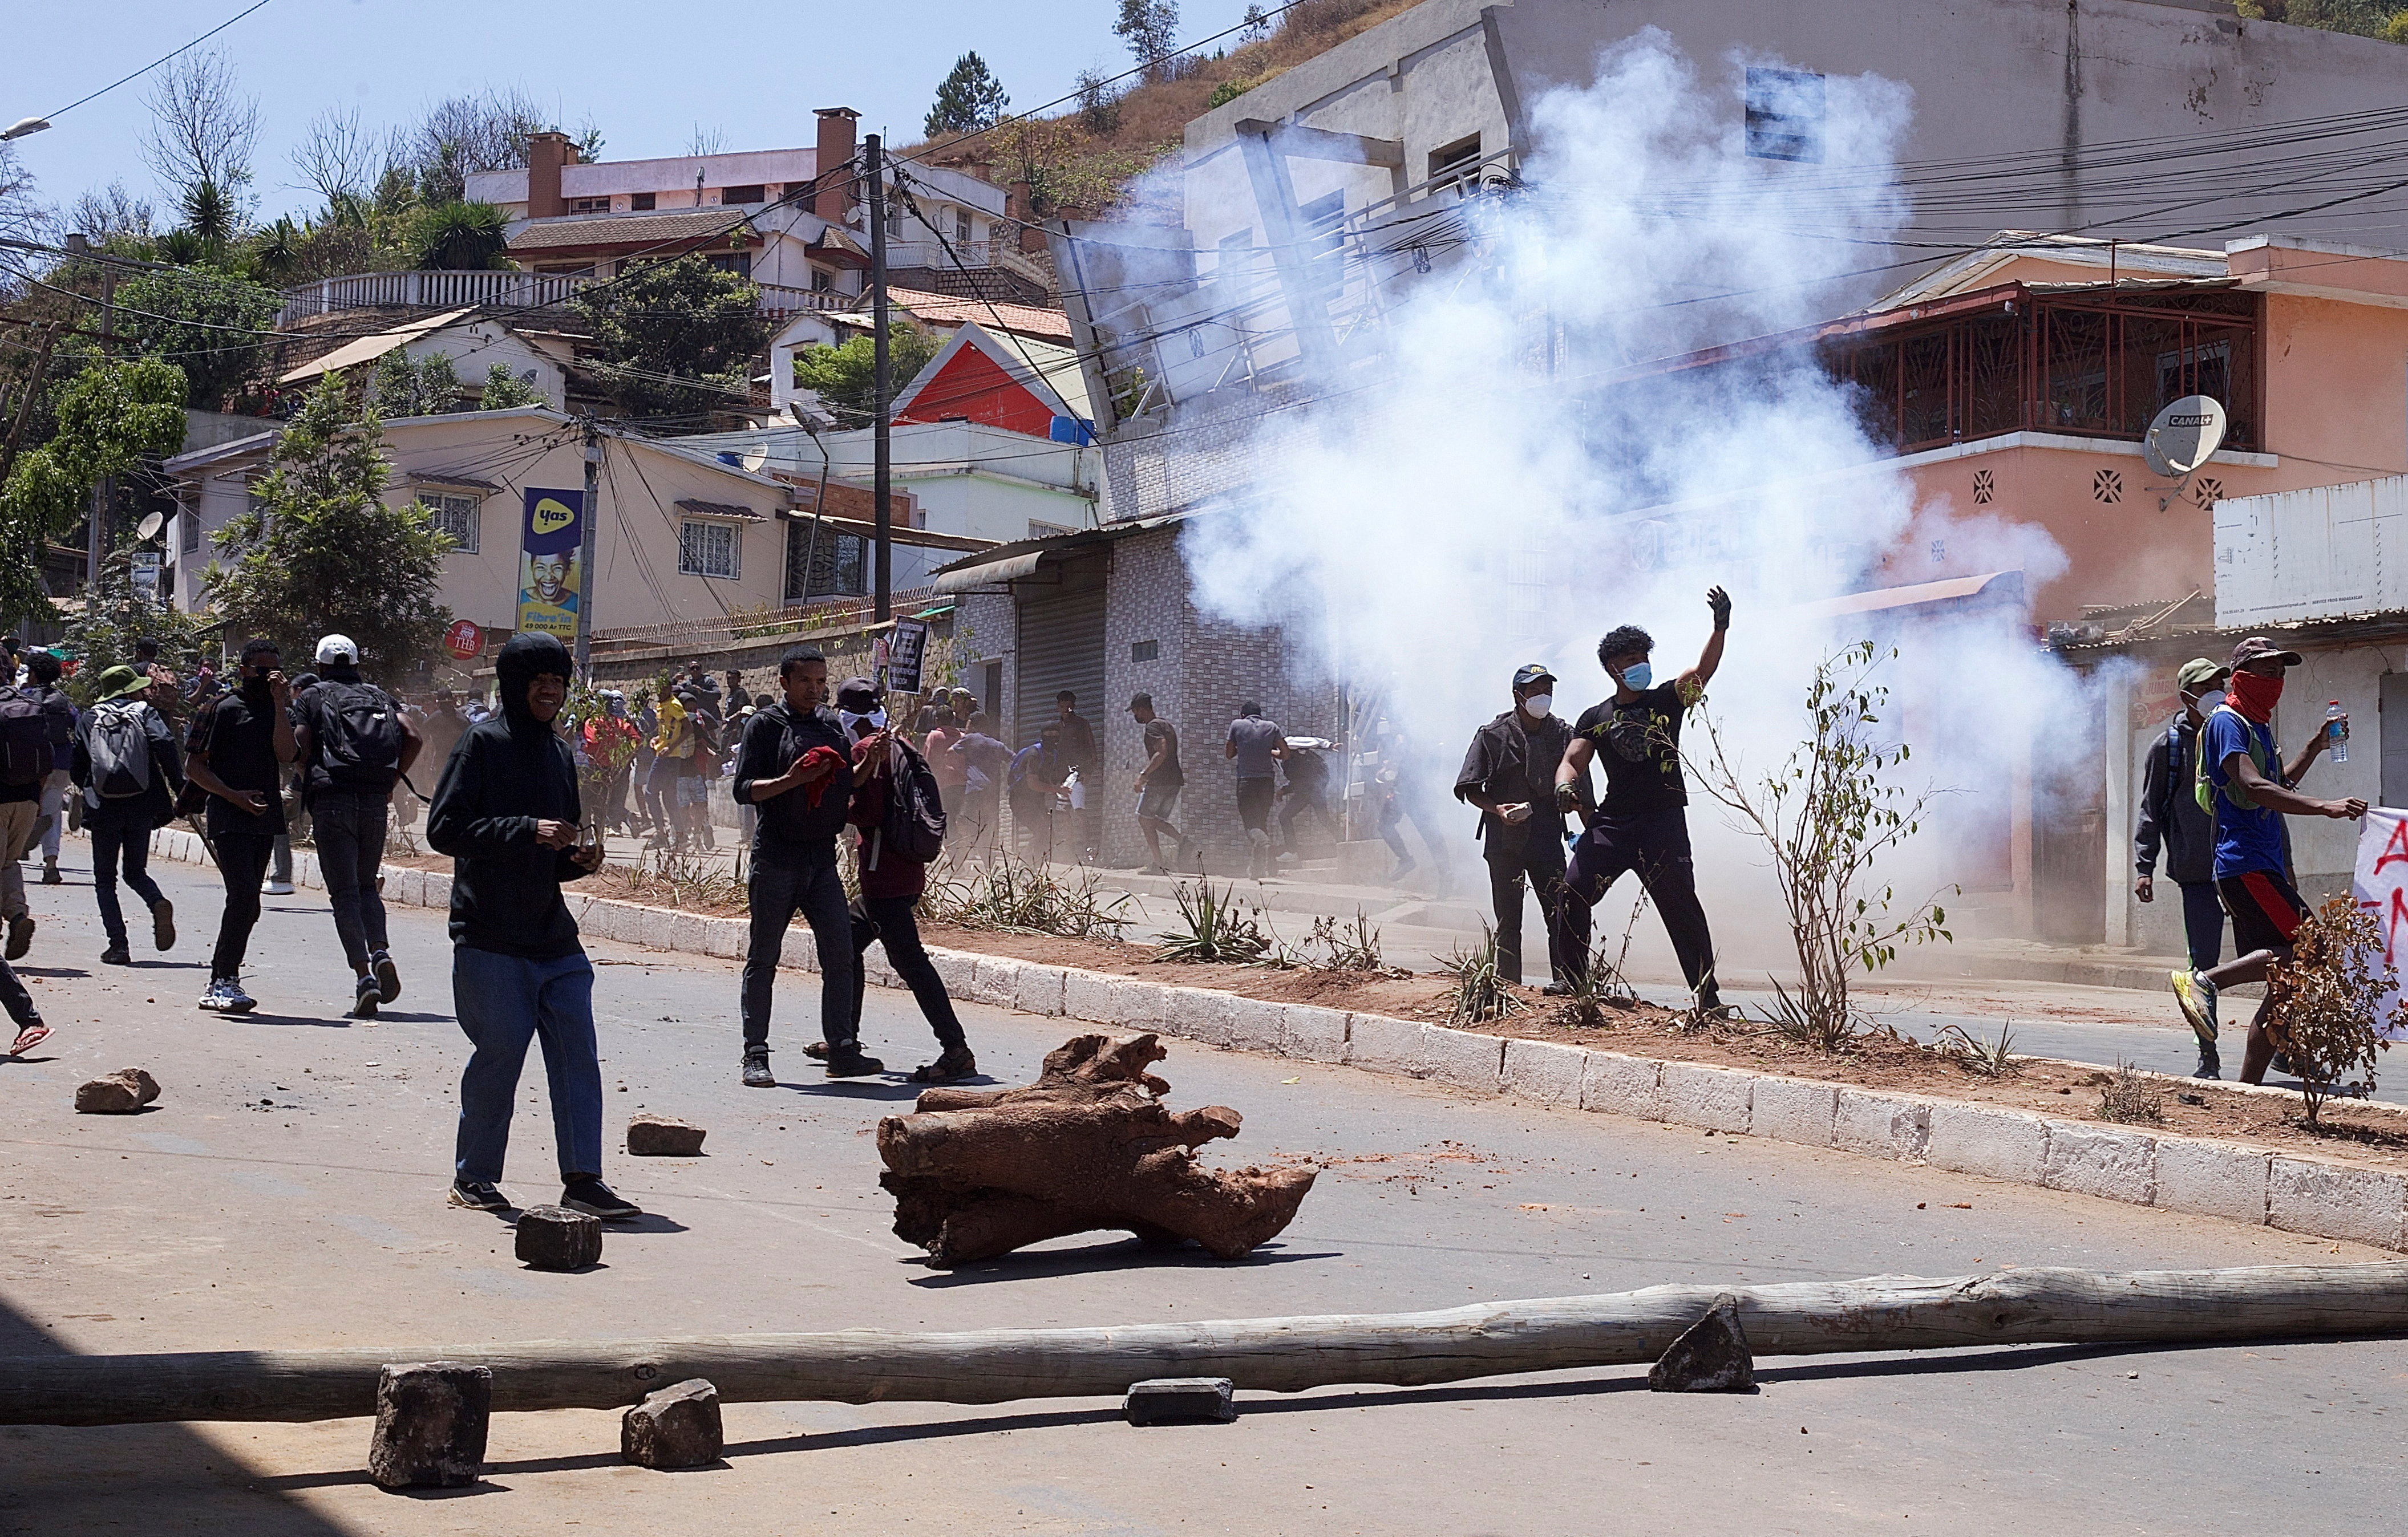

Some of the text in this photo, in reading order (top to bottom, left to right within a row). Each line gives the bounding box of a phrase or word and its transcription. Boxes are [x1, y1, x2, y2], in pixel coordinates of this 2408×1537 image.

[2170, 415, 2212, 426] CANAL+
[539, 509, 568, 526] yas
[455, 636, 475, 651] THB
[2145, 680, 2175, 695] JUMBO
